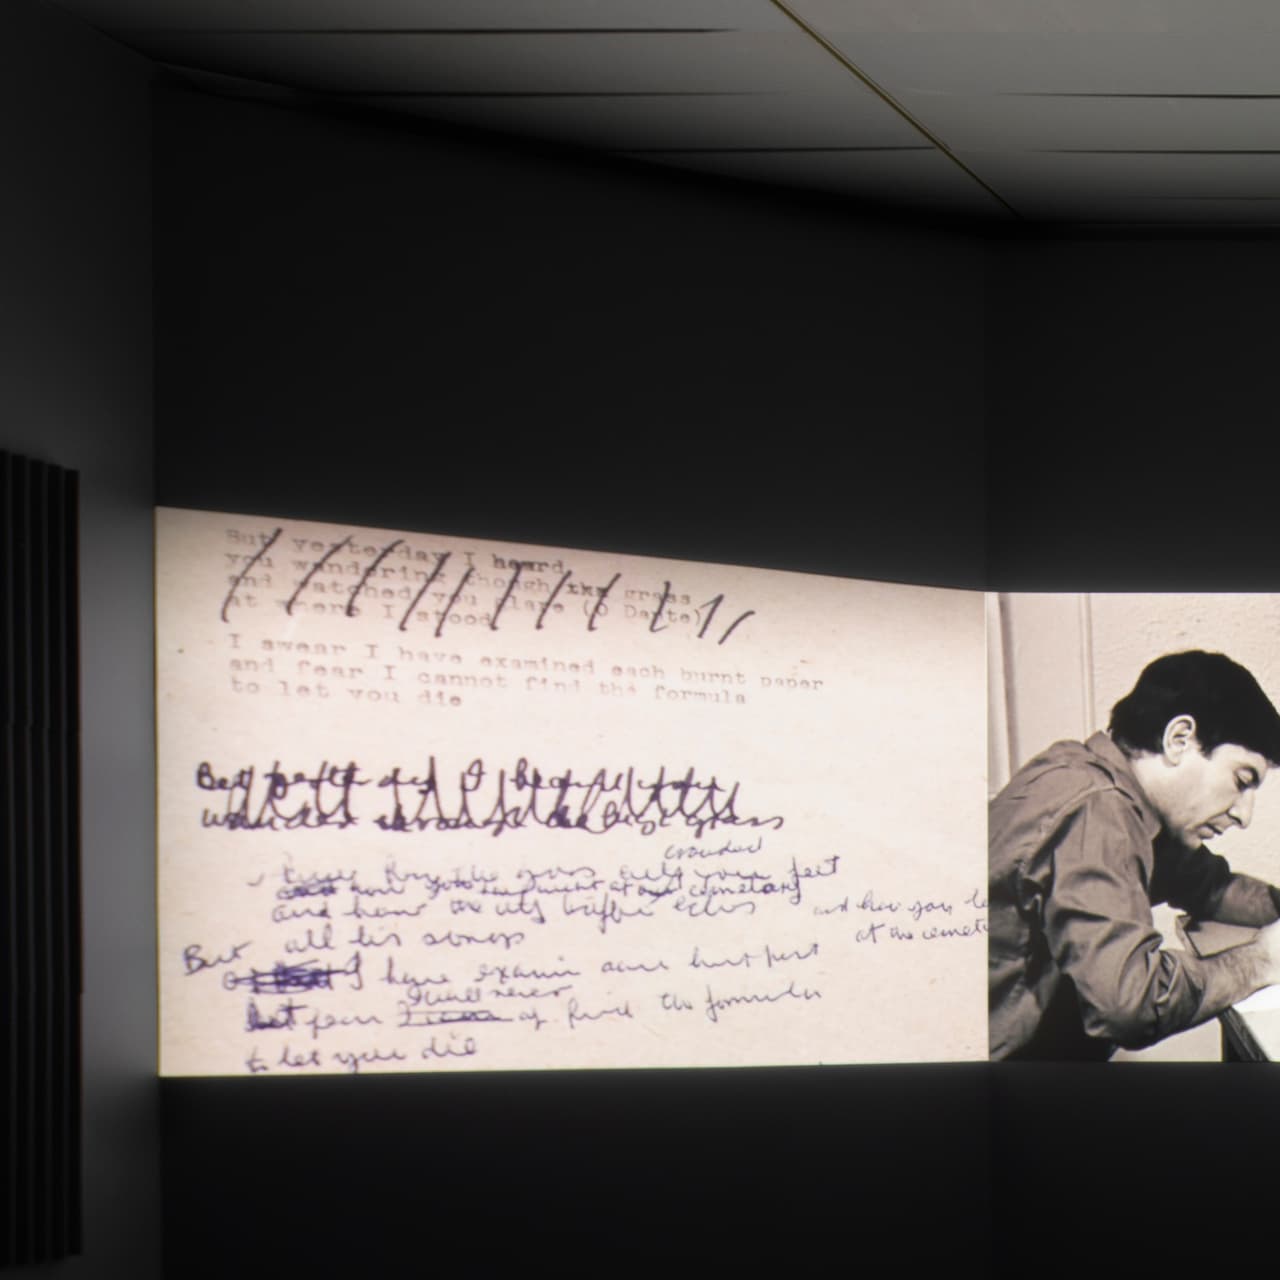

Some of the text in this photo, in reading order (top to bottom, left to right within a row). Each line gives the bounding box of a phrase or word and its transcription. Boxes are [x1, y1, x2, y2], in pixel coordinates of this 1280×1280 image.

[227, 632, 242, 649] I
[261, 637, 347, 656] swear
[366, 643, 380, 659] I
[398, 645, 462, 664] have
[480, 653, 596, 676] examined
[229, 656, 275, 672] and
[384, 664, 397, 681] I
[417, 668, 508, 690] cannot
[654, 683, 747, 706] formula
[230, 677, 463, 708] to let you die
